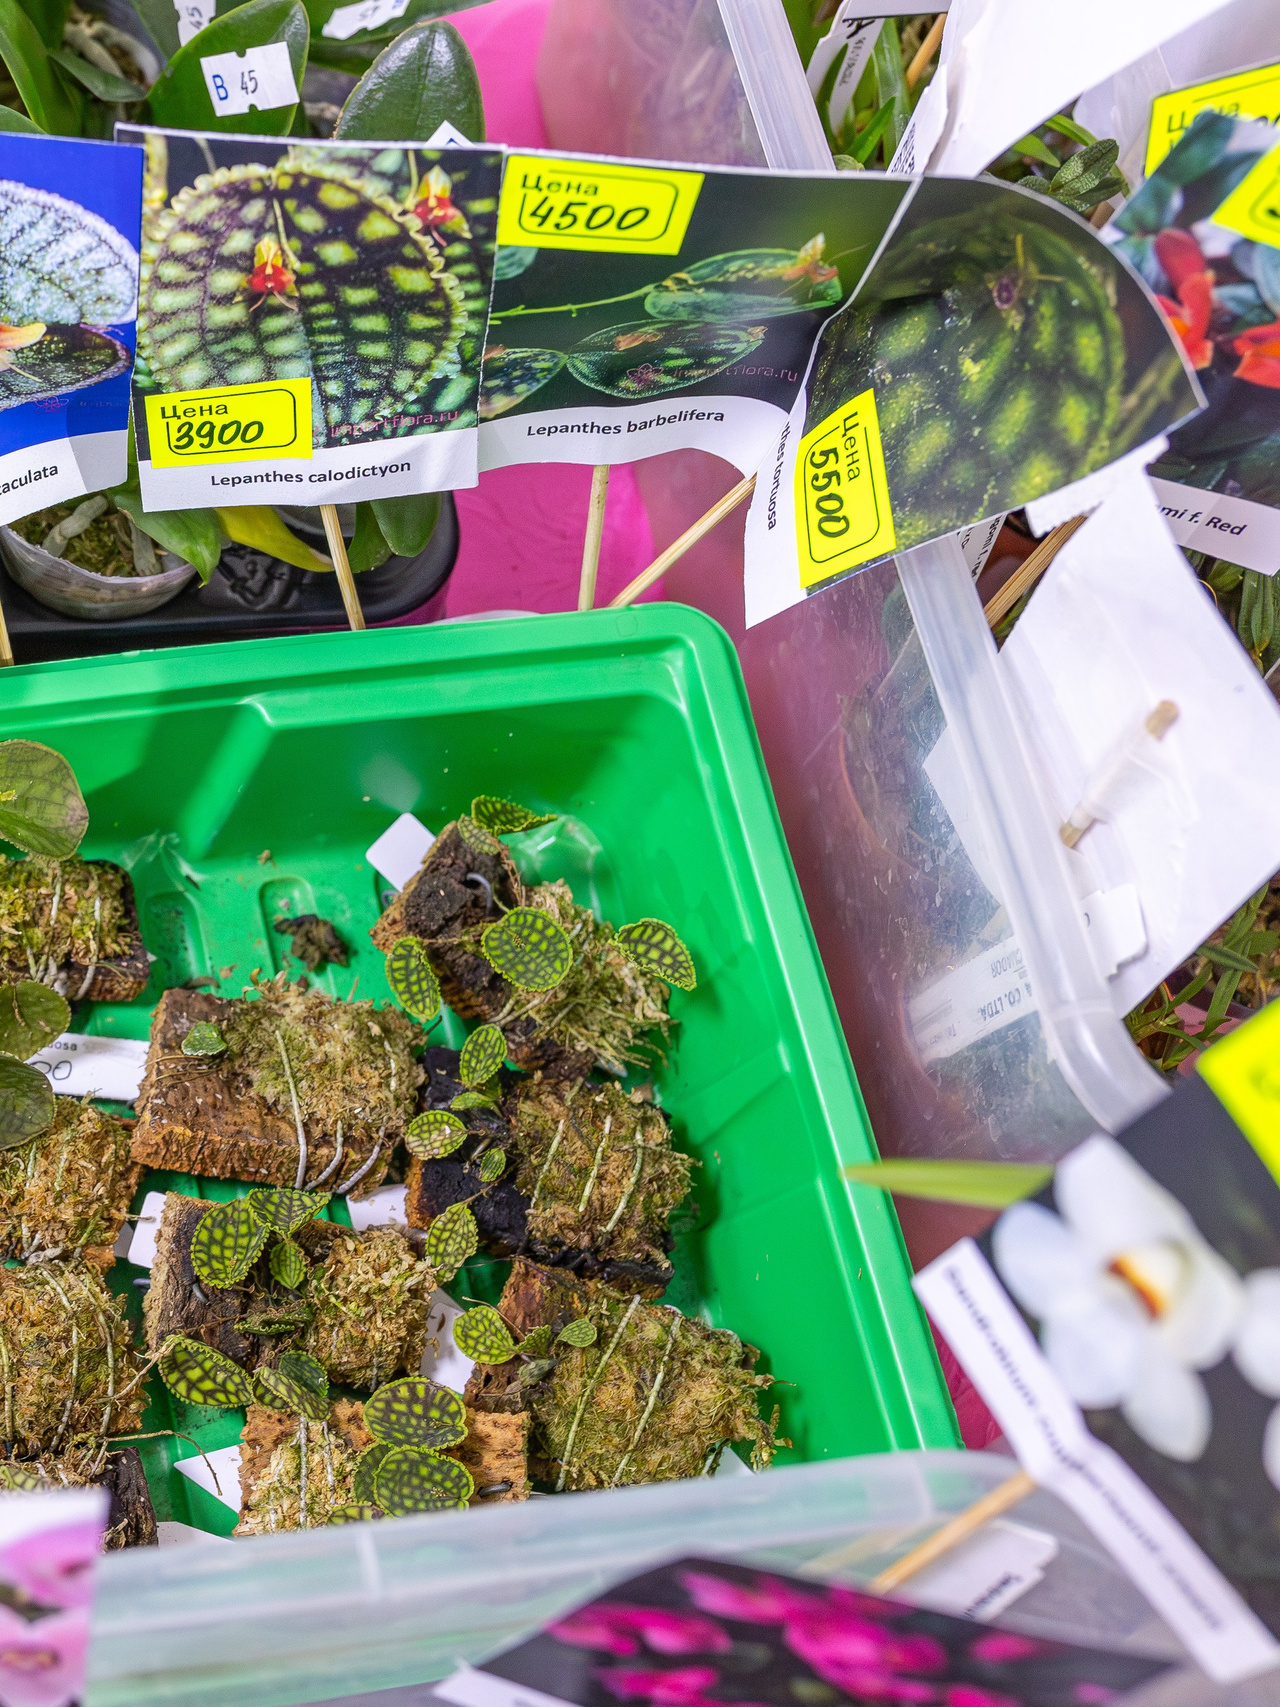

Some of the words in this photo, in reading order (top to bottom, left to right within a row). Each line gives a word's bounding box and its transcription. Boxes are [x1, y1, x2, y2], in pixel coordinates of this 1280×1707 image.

[240, 70, 258, 95] 45
[521, 174, 599, 196] Цена
[529, 196, 650, 231] 4500
[161, 402, 229, 420] Цена
[527, 421, 622, 437] Lepanthes
[626, 408, 725, 434] barbelifera
[174, 420, 264, 450] 3900
[841, 411, 861, 484] Цена
[211, 470, 304, 488] Lepanthes
[308, 461, 411, 483] calodictyon
[767, 461, 784, 531] tortuosa
[809, 447, 850, 538] 5500
[1205, 516, 1248, 536] Red
